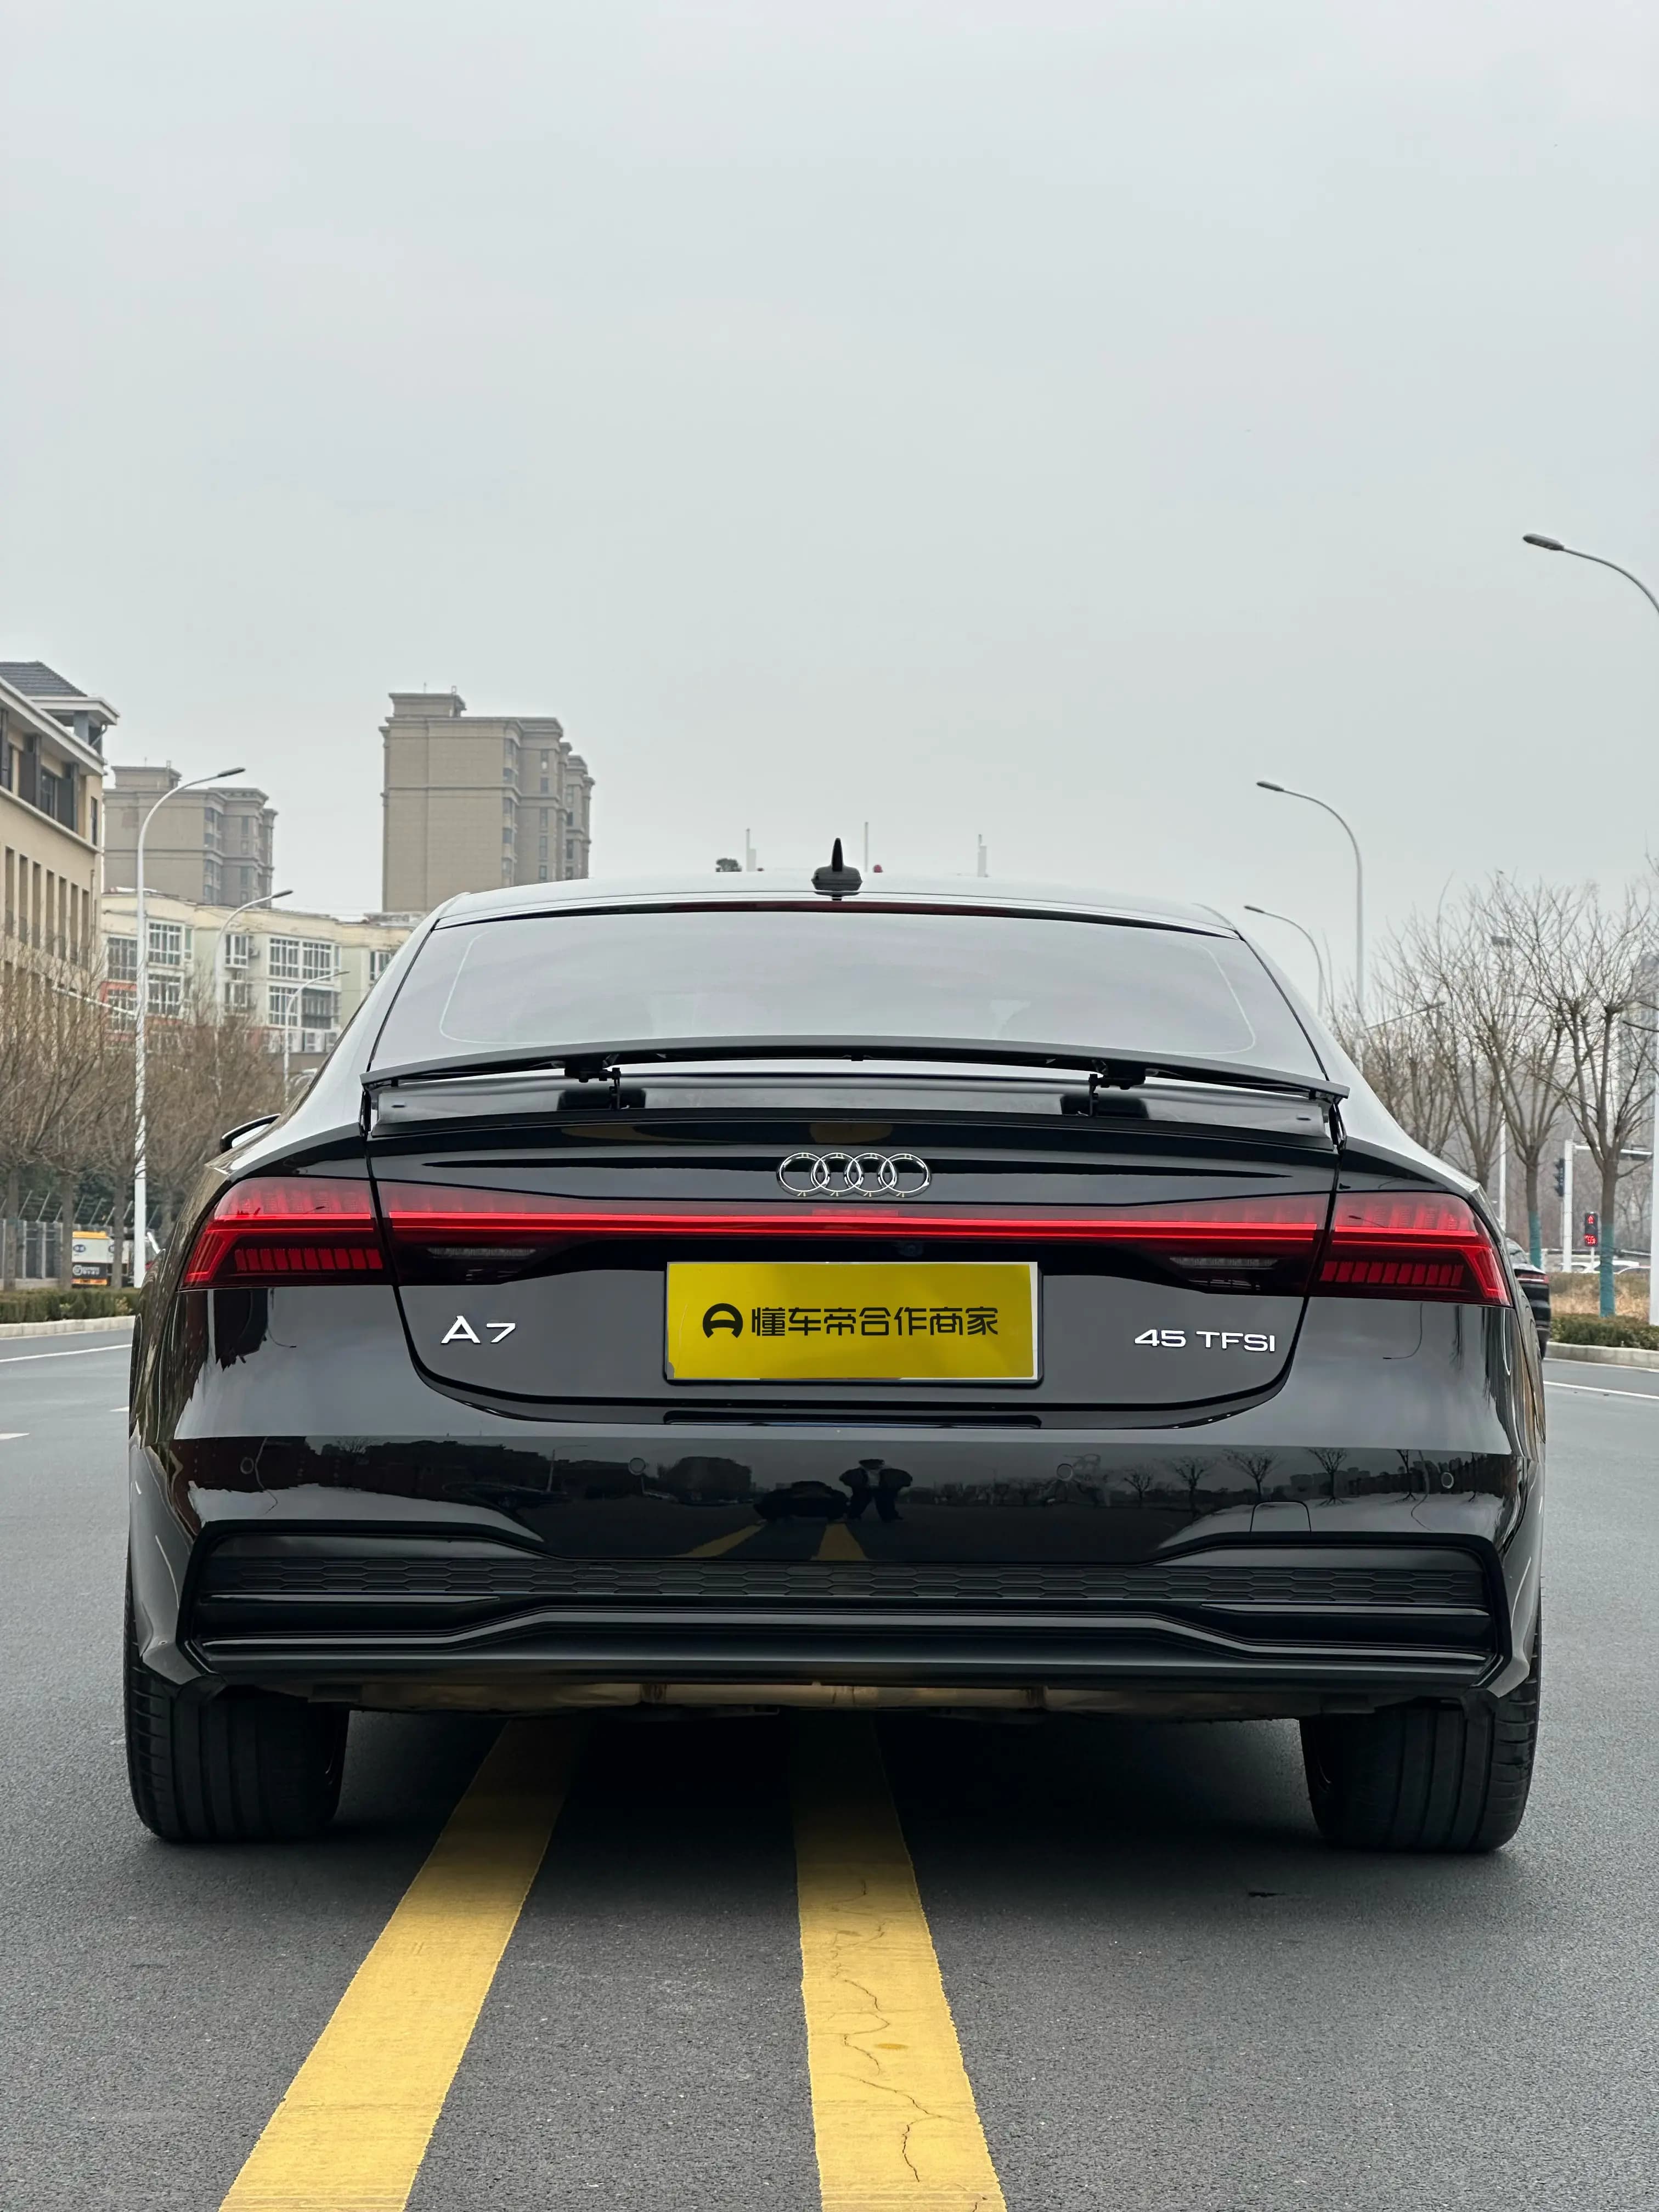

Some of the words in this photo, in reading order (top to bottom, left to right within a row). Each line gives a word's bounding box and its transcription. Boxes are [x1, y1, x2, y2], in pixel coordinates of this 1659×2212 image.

[441, 1316, 516, 1344] A7
[751, 1306, 998, 1336] 懂车帝合作商家
[1135, 1329, 1187, 1347] 45
[1196, 1331, 1276, 1352] TFSI
